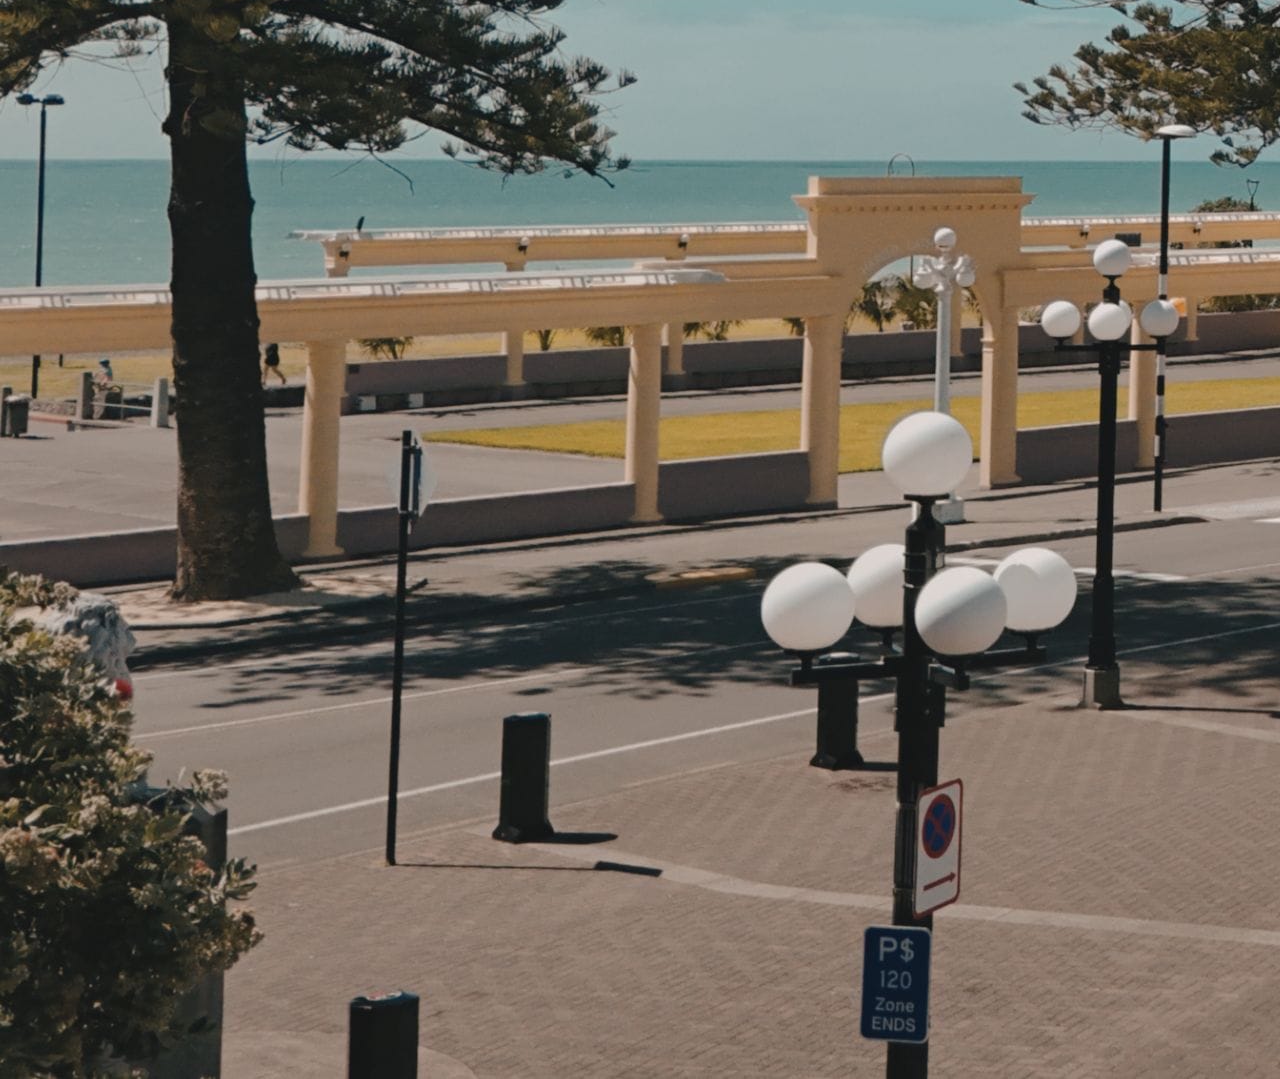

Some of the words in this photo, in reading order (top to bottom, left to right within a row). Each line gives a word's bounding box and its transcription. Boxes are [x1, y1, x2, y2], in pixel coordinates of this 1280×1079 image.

[879, 937, 915, 962] P$
[880, 970, 913, 989] 120
[875, 997, 915, 1013] Zone
[872, 1016, 916, 1032] ENDS
